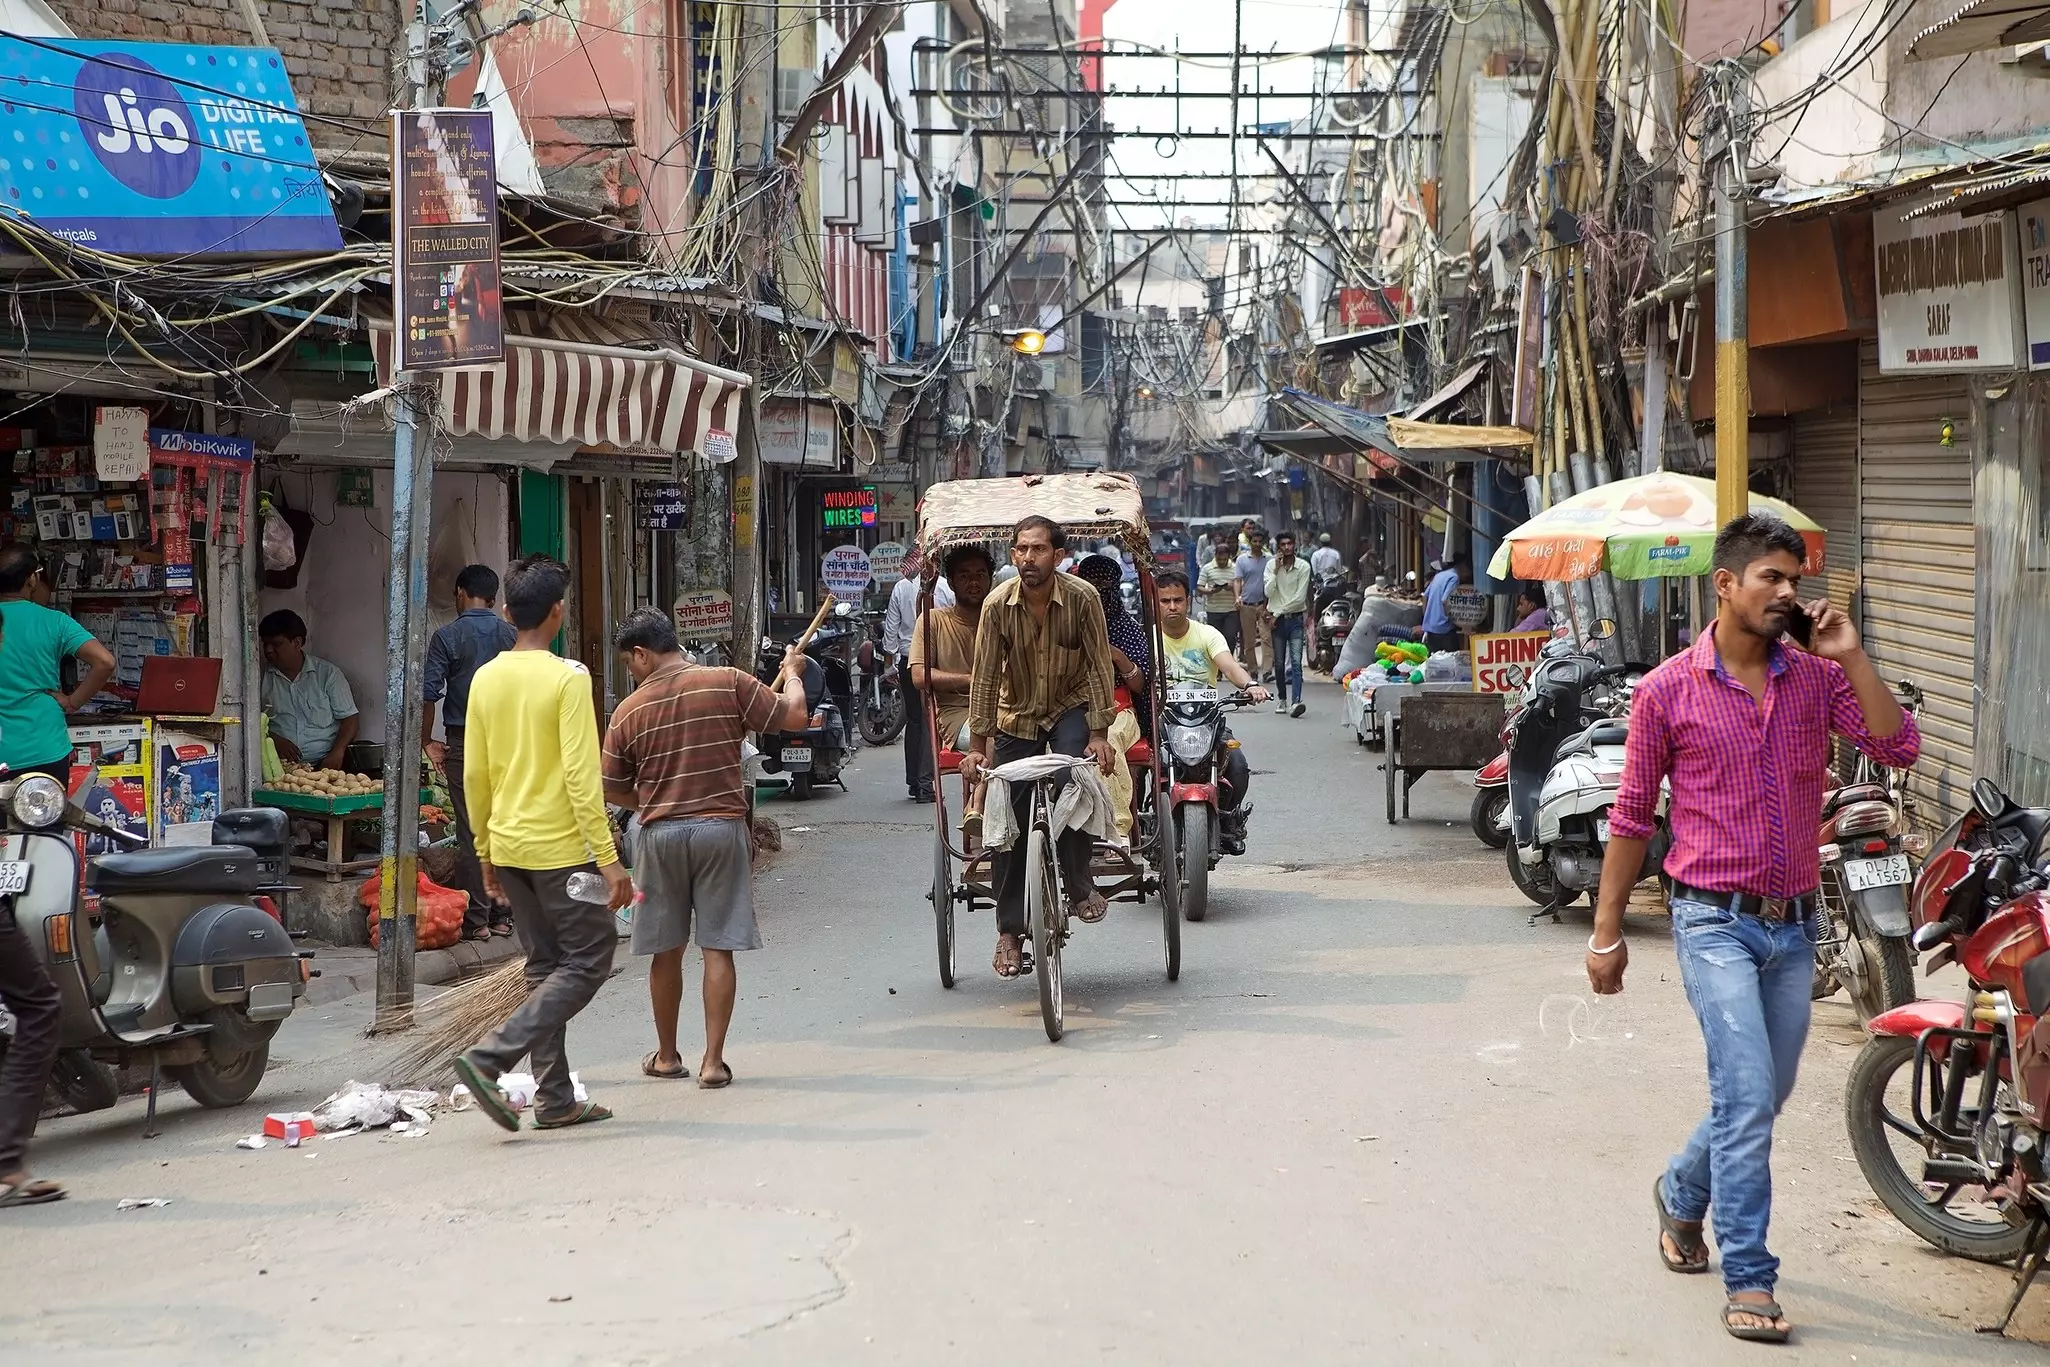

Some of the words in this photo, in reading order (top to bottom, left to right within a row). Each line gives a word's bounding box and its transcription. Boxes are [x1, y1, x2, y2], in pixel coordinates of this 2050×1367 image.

[200, 98, 298, 124] DIGITAL
[97, 87, 190, 154] Jio
[211, 128, 267, 154] LIFE
[460, 126, 473, 143] only
[466, 163, 488, 181] offering
[412, 239, 430, 252] THE
[431, 237, 468, 251] WALLED
[469, 237, 489, 250] CITY
[105, 409, 141, 421] HAND
[112, 427, 129, 438] TO
[106, 441, 135, 451] HAND
[161, 433, 242, 457] MobiKwik
[824, 490, 875, 508] WINDING
[824, 508, 862, 526] WIRES
[834, 551, 860, 562] पुराना
[1651, 547, 1688, 557] FARM-PIK
[688, 595, 714, 605] पुराना
[688, 617, 707, 627] गोटा
[1186, 692, 1195, 700] SN
[0, 863, 18, 876] 5S
[1866, 858, 1900, 873] DL7S
[1860, 869, 1908, 888] AL1567
